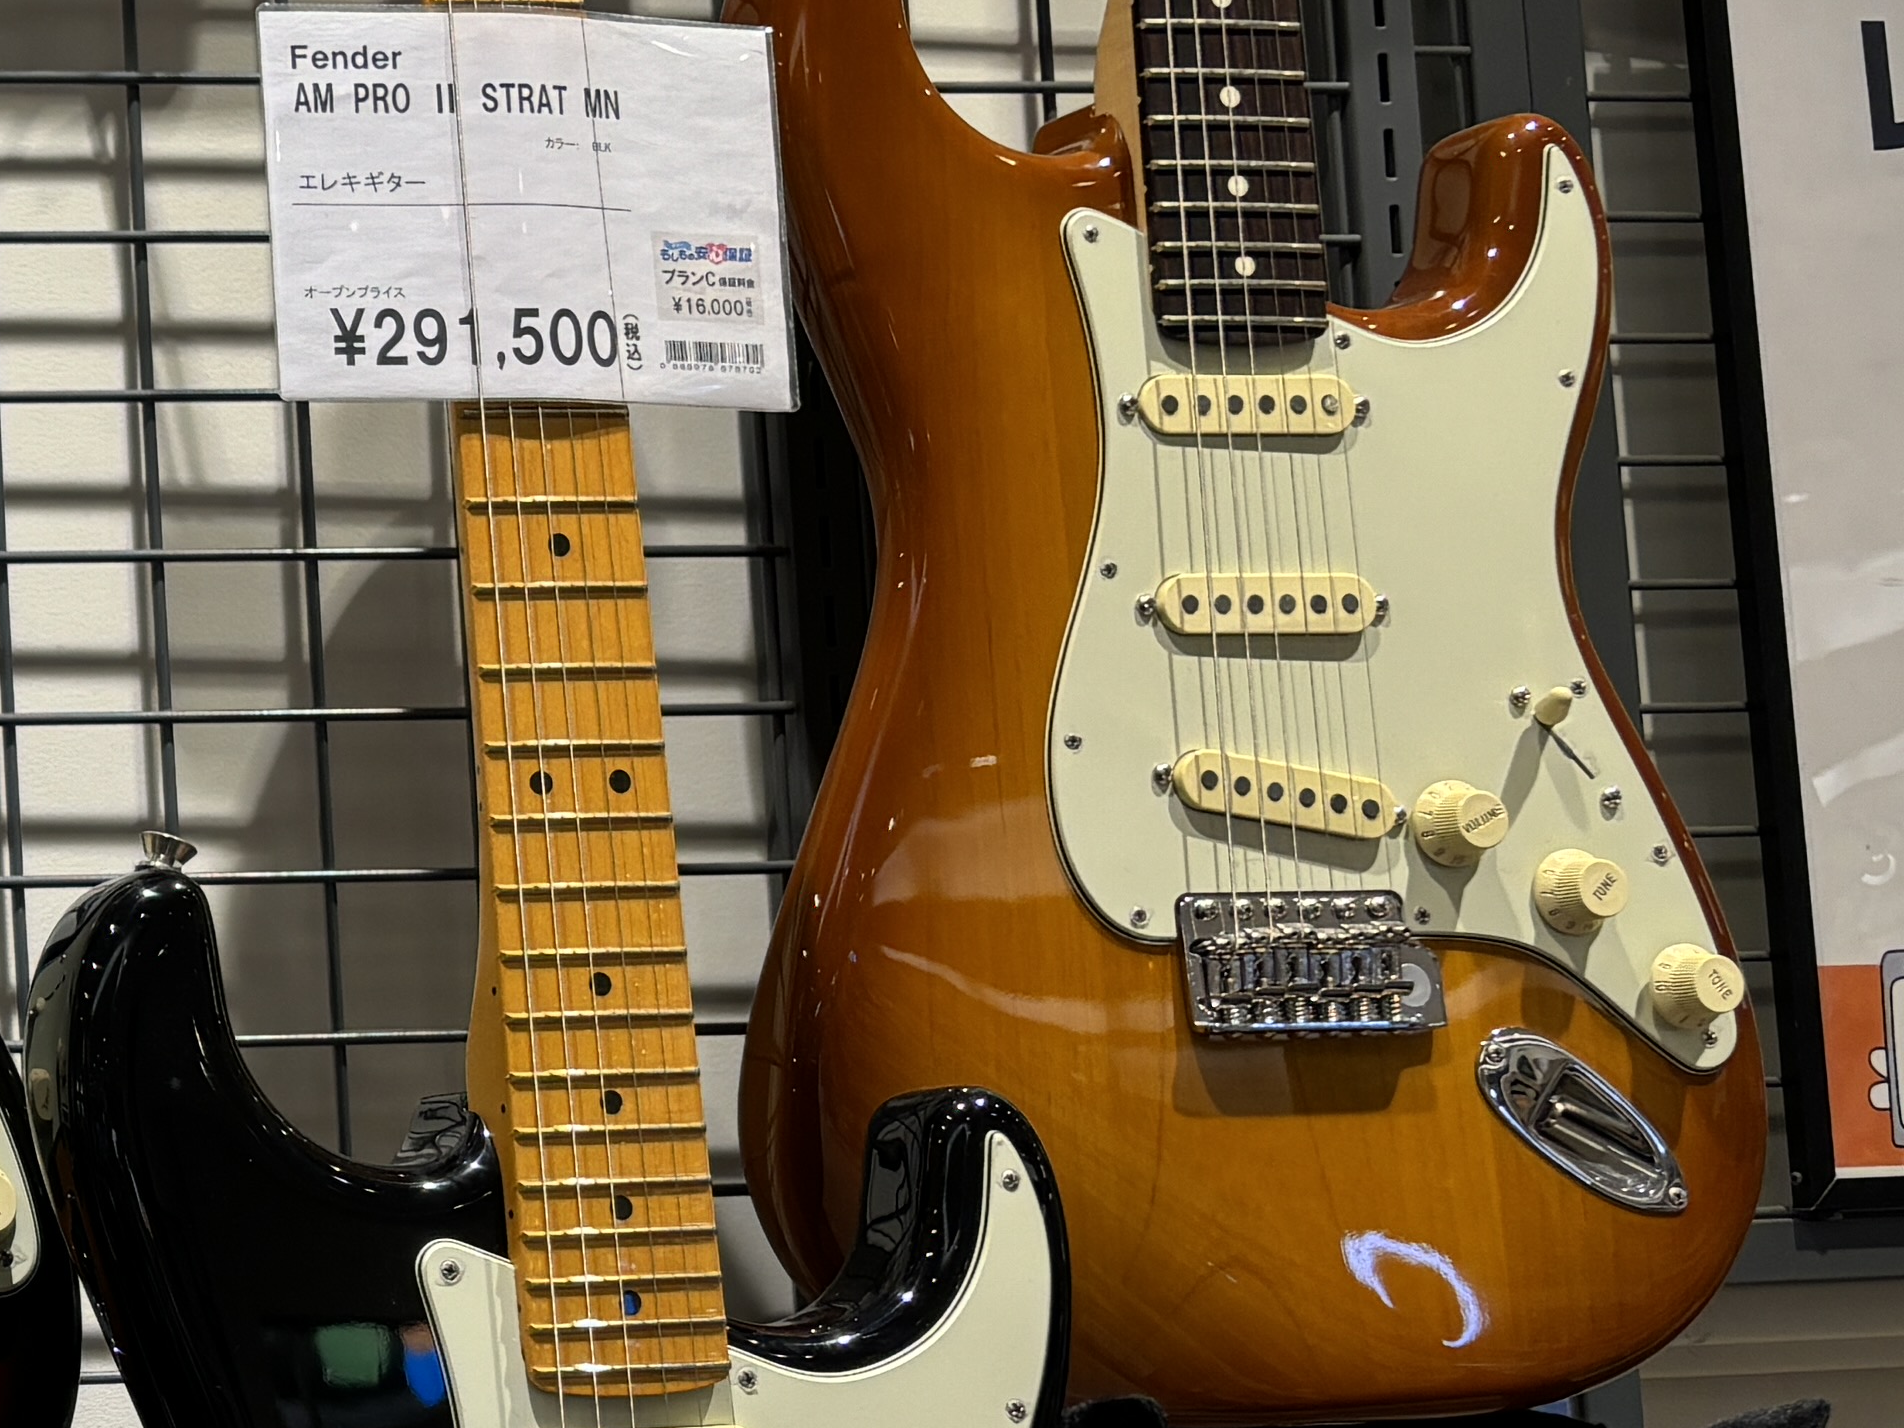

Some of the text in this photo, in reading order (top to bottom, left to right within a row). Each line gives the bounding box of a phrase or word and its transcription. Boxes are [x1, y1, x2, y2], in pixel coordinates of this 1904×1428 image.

[291, 45, 402, 70] Fender
[294, 82, 334, 113] AM
[354, 82, 411, 114] PRO
[481, 83, 567, 117] STRAT
[584, 88, 620, 121] MN
[299, 172, 426, 193] エレキギター
[672, 296, 744, 316] ¥16,000
[330, 307, 619, 371] ¥291,500
